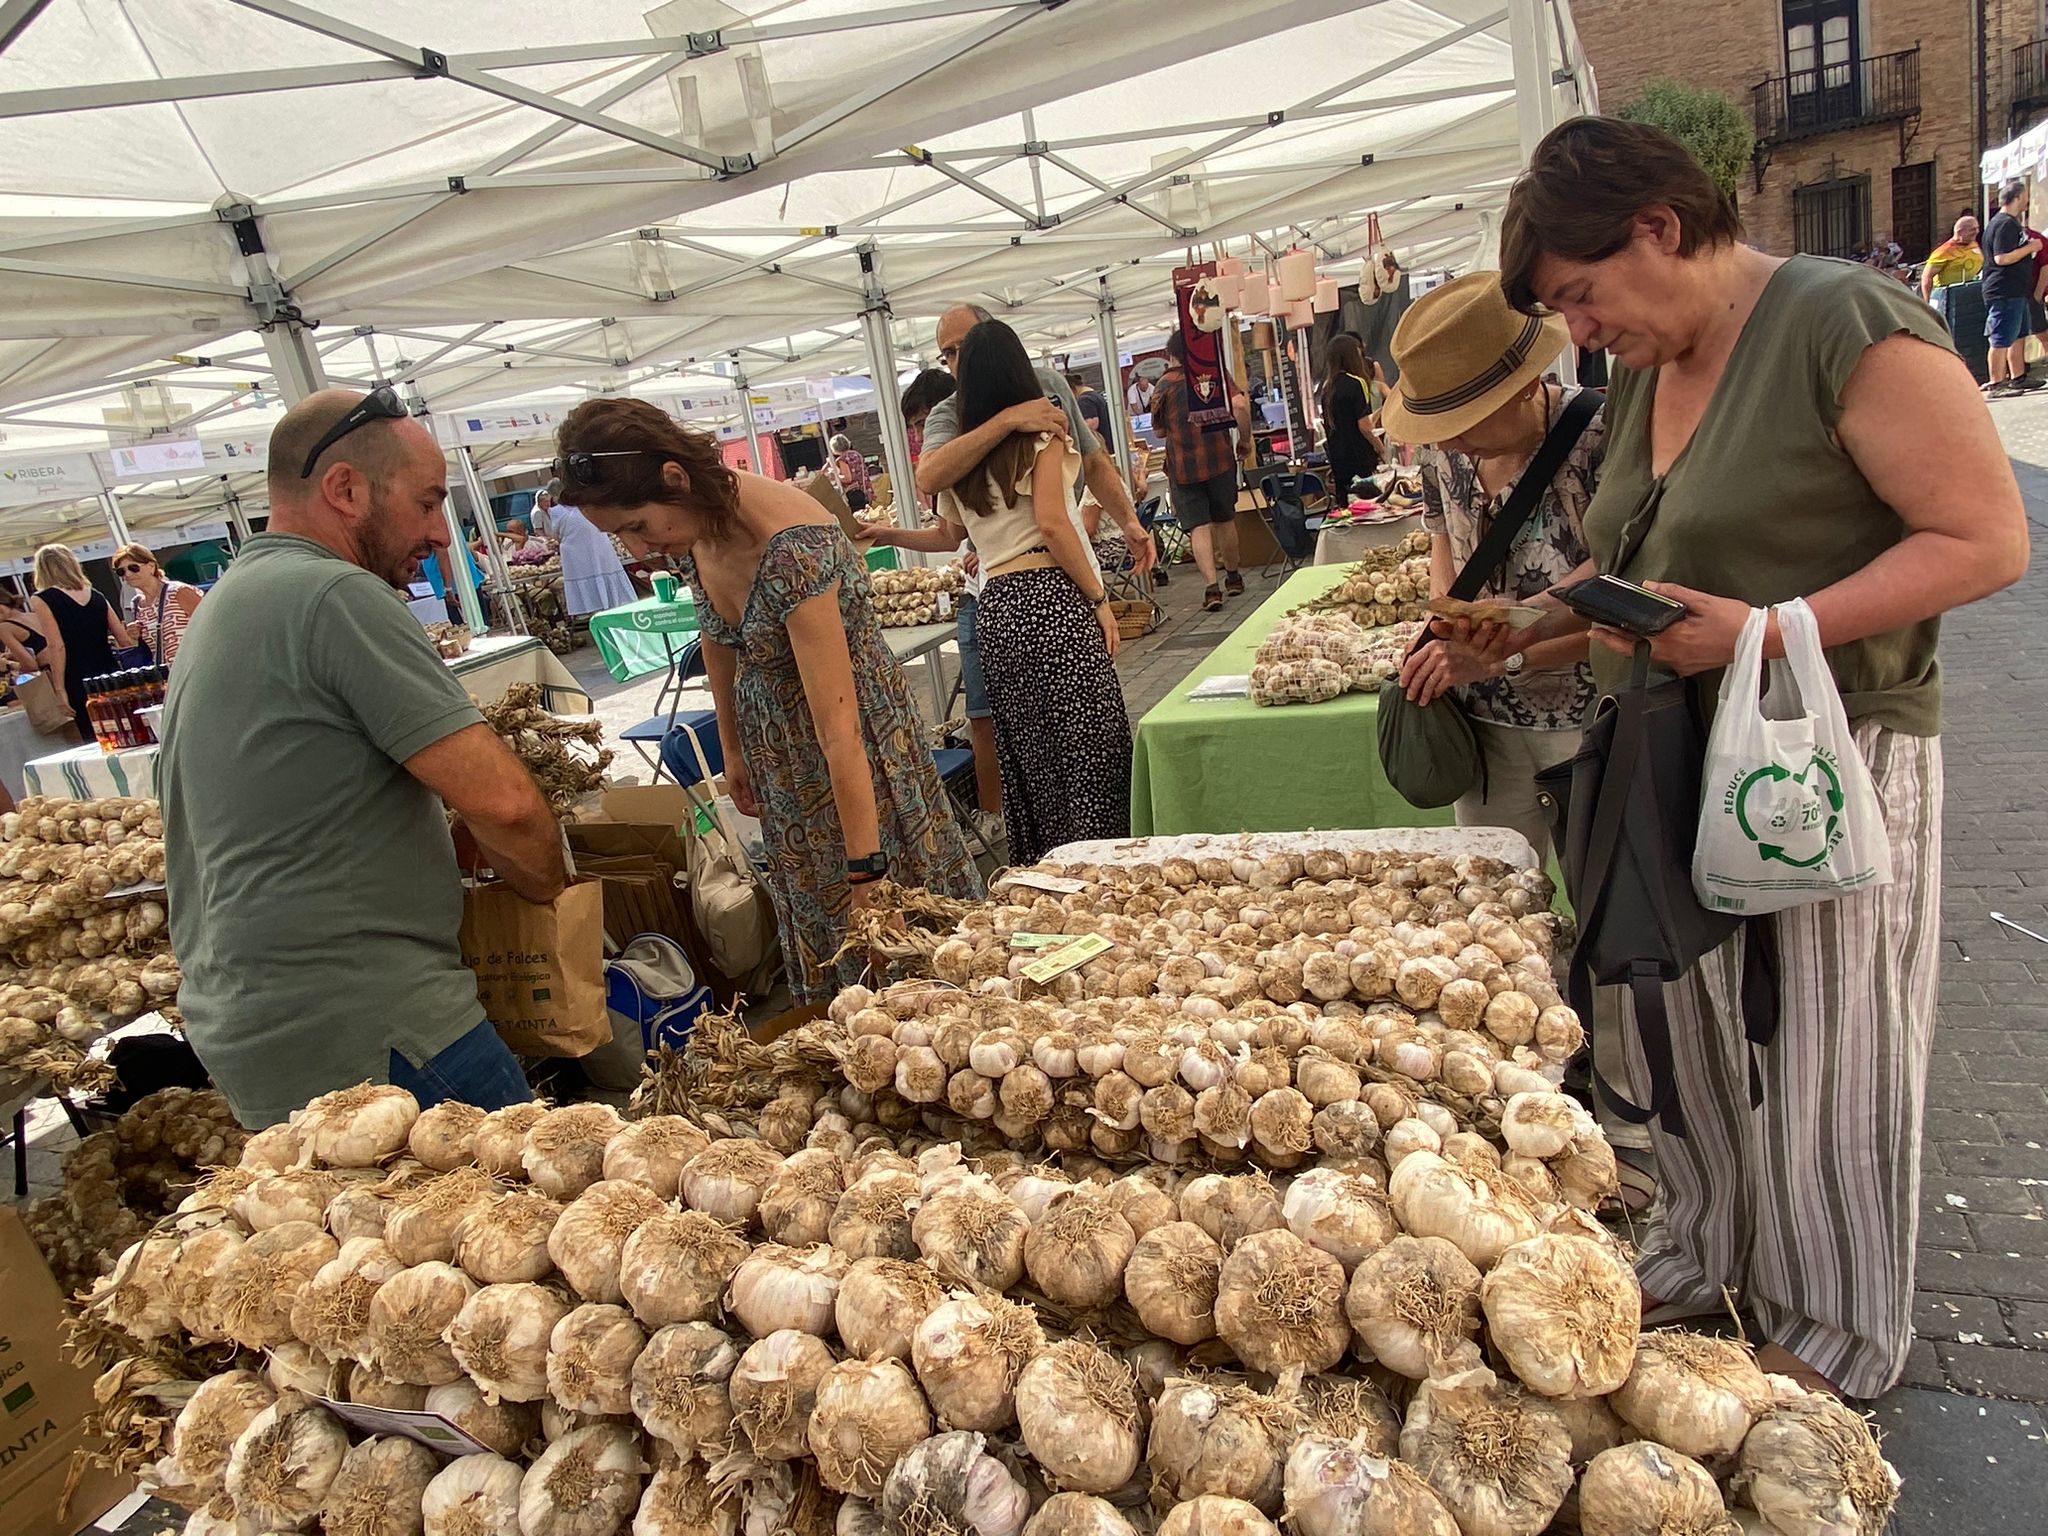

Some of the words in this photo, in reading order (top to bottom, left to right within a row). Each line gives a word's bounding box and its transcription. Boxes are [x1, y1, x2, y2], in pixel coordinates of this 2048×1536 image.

[17, 466, 66, 479] RIBERA
[1724, 768, 1747, 814] REDUCE
[487, 952, 503, 965] de
[0, 1418, 57, 1469] INTA
